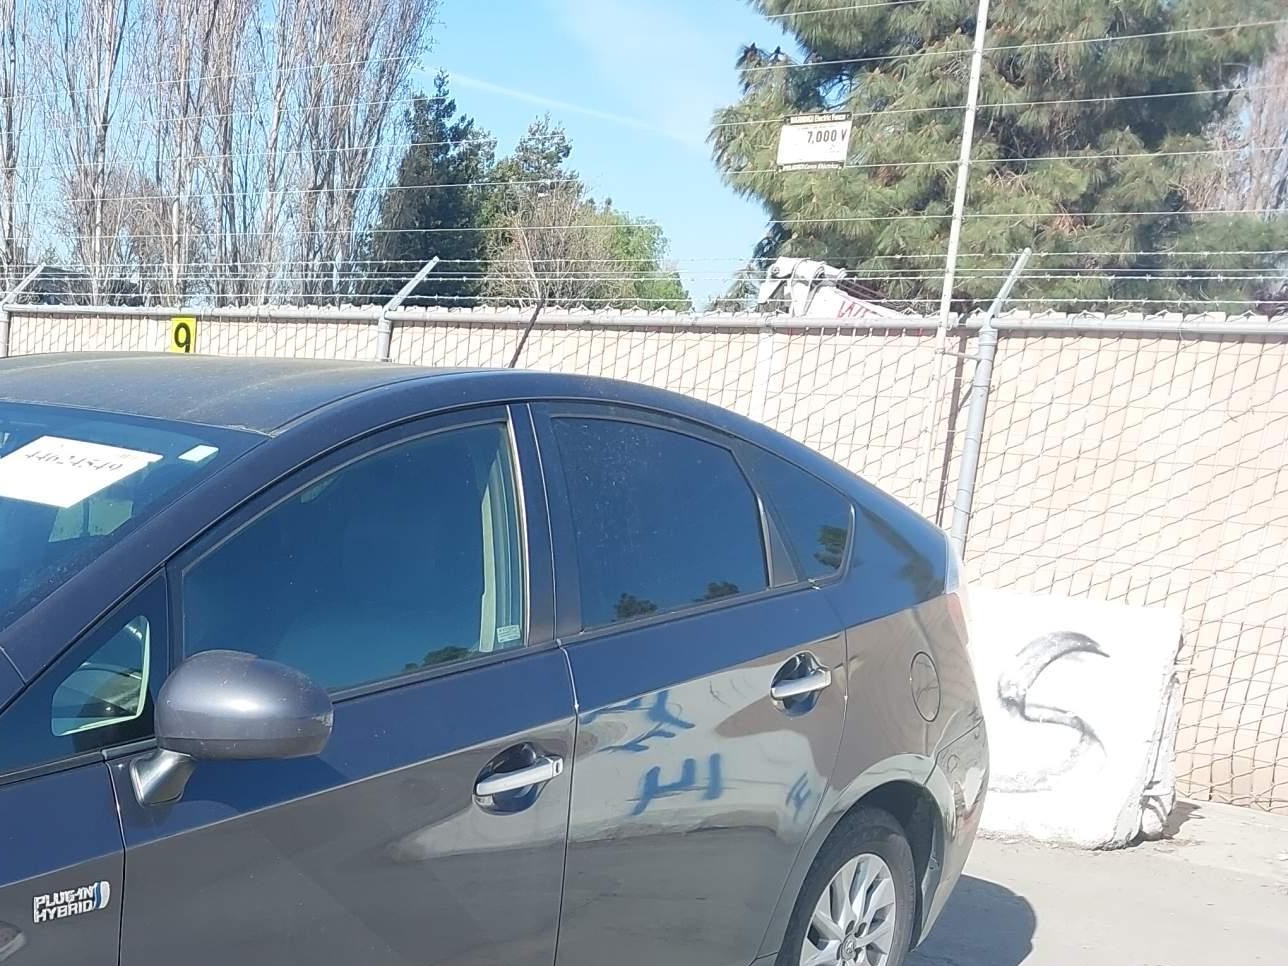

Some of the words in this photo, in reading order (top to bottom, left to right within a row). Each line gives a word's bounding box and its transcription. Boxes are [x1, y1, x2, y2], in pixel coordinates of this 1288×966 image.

[807, 129, 838, 144] 7,000
[841, 128, 848, 141] V
[174, 322, 191, 353] 9
[33, 885, 95, 909] PLUG-IN
[33, 899, 95, 923] HYBRID
